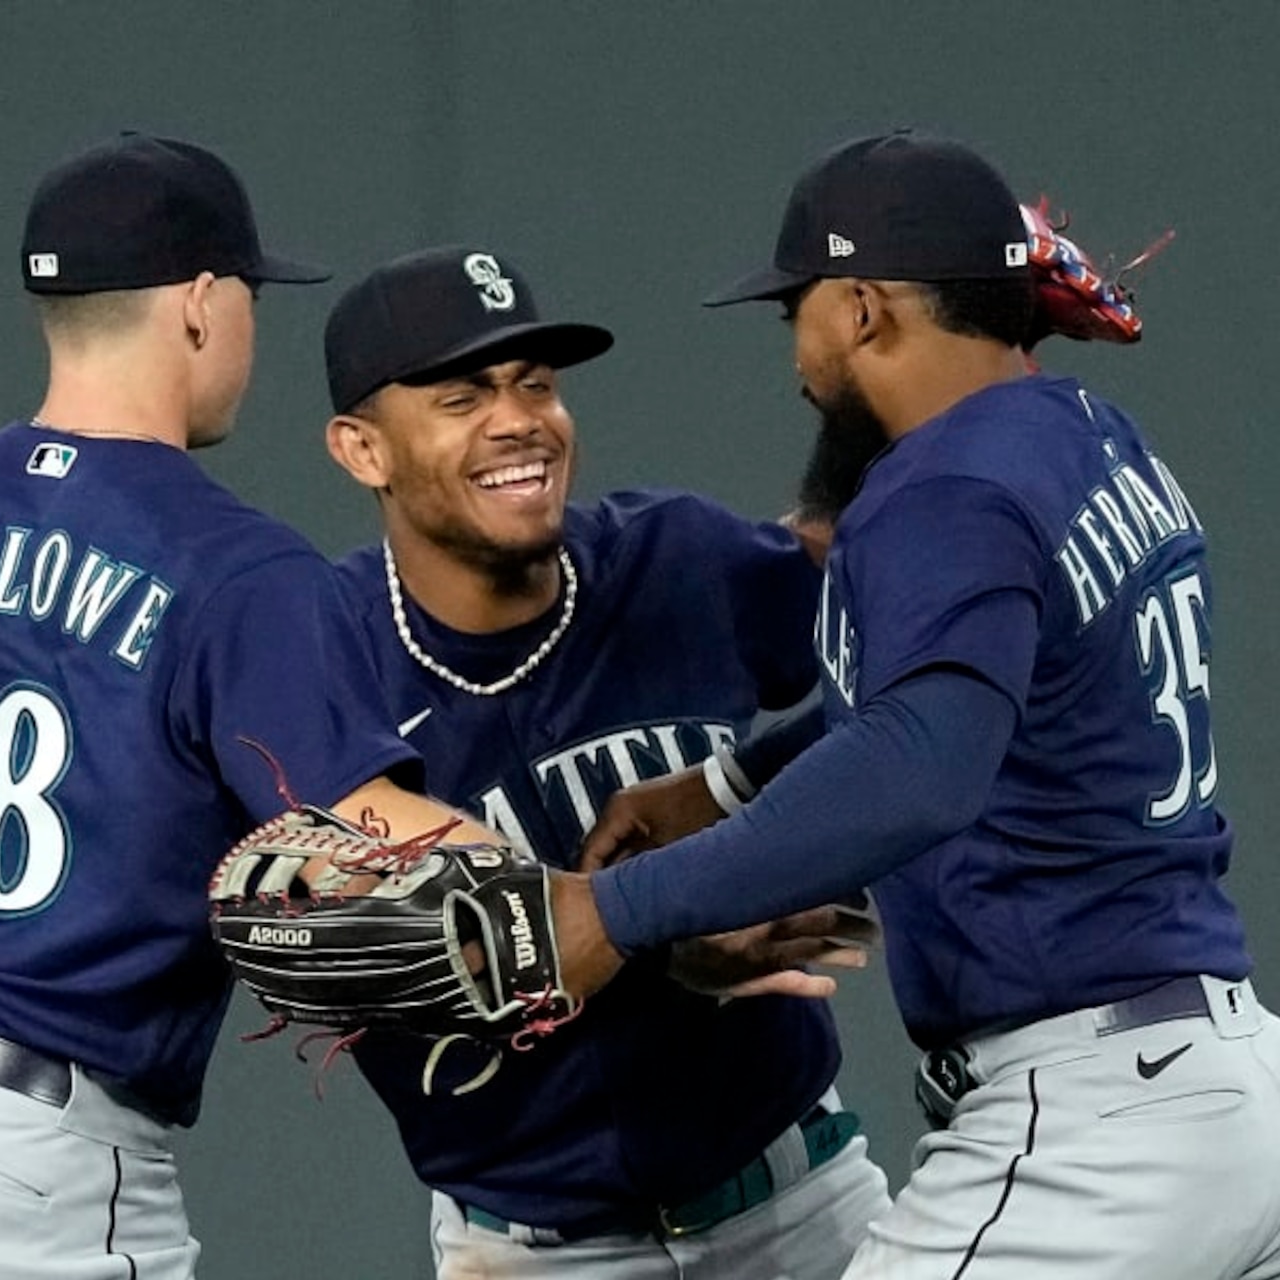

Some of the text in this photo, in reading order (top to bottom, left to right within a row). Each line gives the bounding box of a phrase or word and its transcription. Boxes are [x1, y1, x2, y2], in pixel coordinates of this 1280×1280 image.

[1132, 560, 1220, 828] 35
[248, 925, 312, 946] A2000
[509, 892, 538, 970] Wilson
